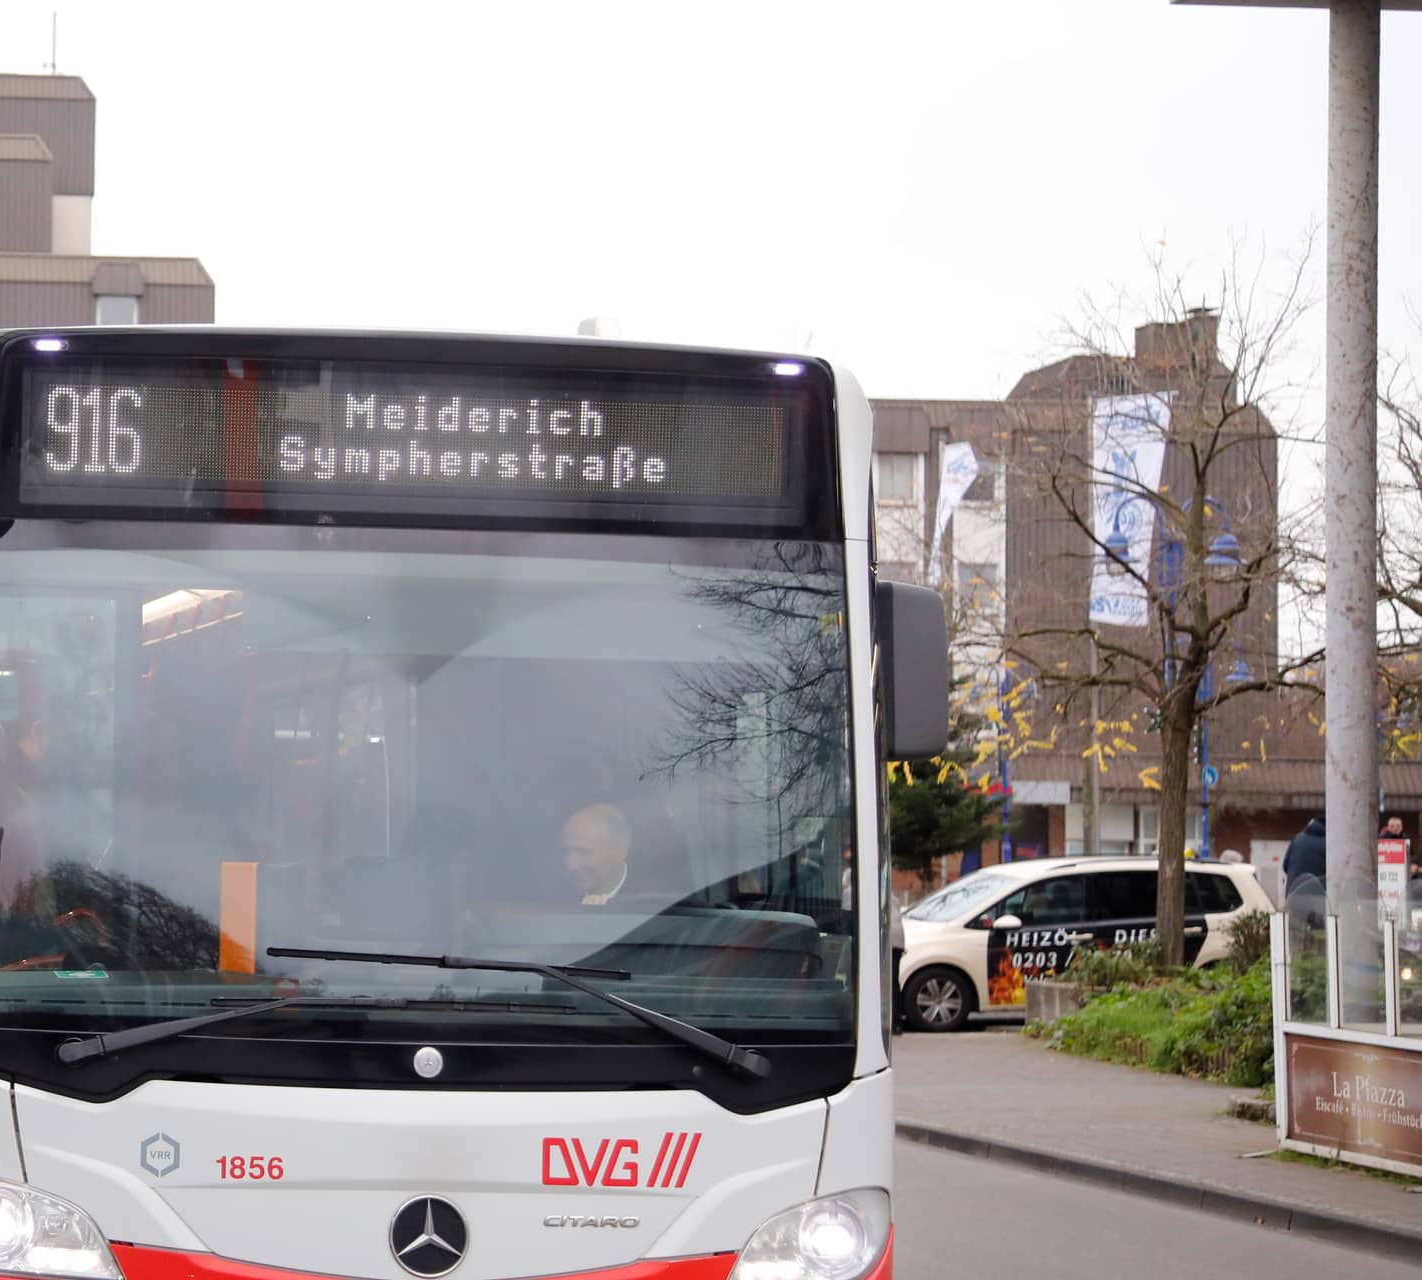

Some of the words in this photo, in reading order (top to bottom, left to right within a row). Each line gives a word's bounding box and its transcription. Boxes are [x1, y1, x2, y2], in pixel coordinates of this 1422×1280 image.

[46, 387, 141, 473] 916
[345, 394, 604, 436] Meiderich
[280, 436, 667, 488] Sympherstraße
[1012, 951, 1057, 968] 0203
[1332, 1071, 1350, 1099] La
[1355, 1074, 1406, 1109] Piazza
[149, 1150, 171, 1160] VRR
[216, 1155, 284, 1180] 1856
[542, 1137, 639, 1187] DVG
[543, 1215, 641, 1229] CITARO
